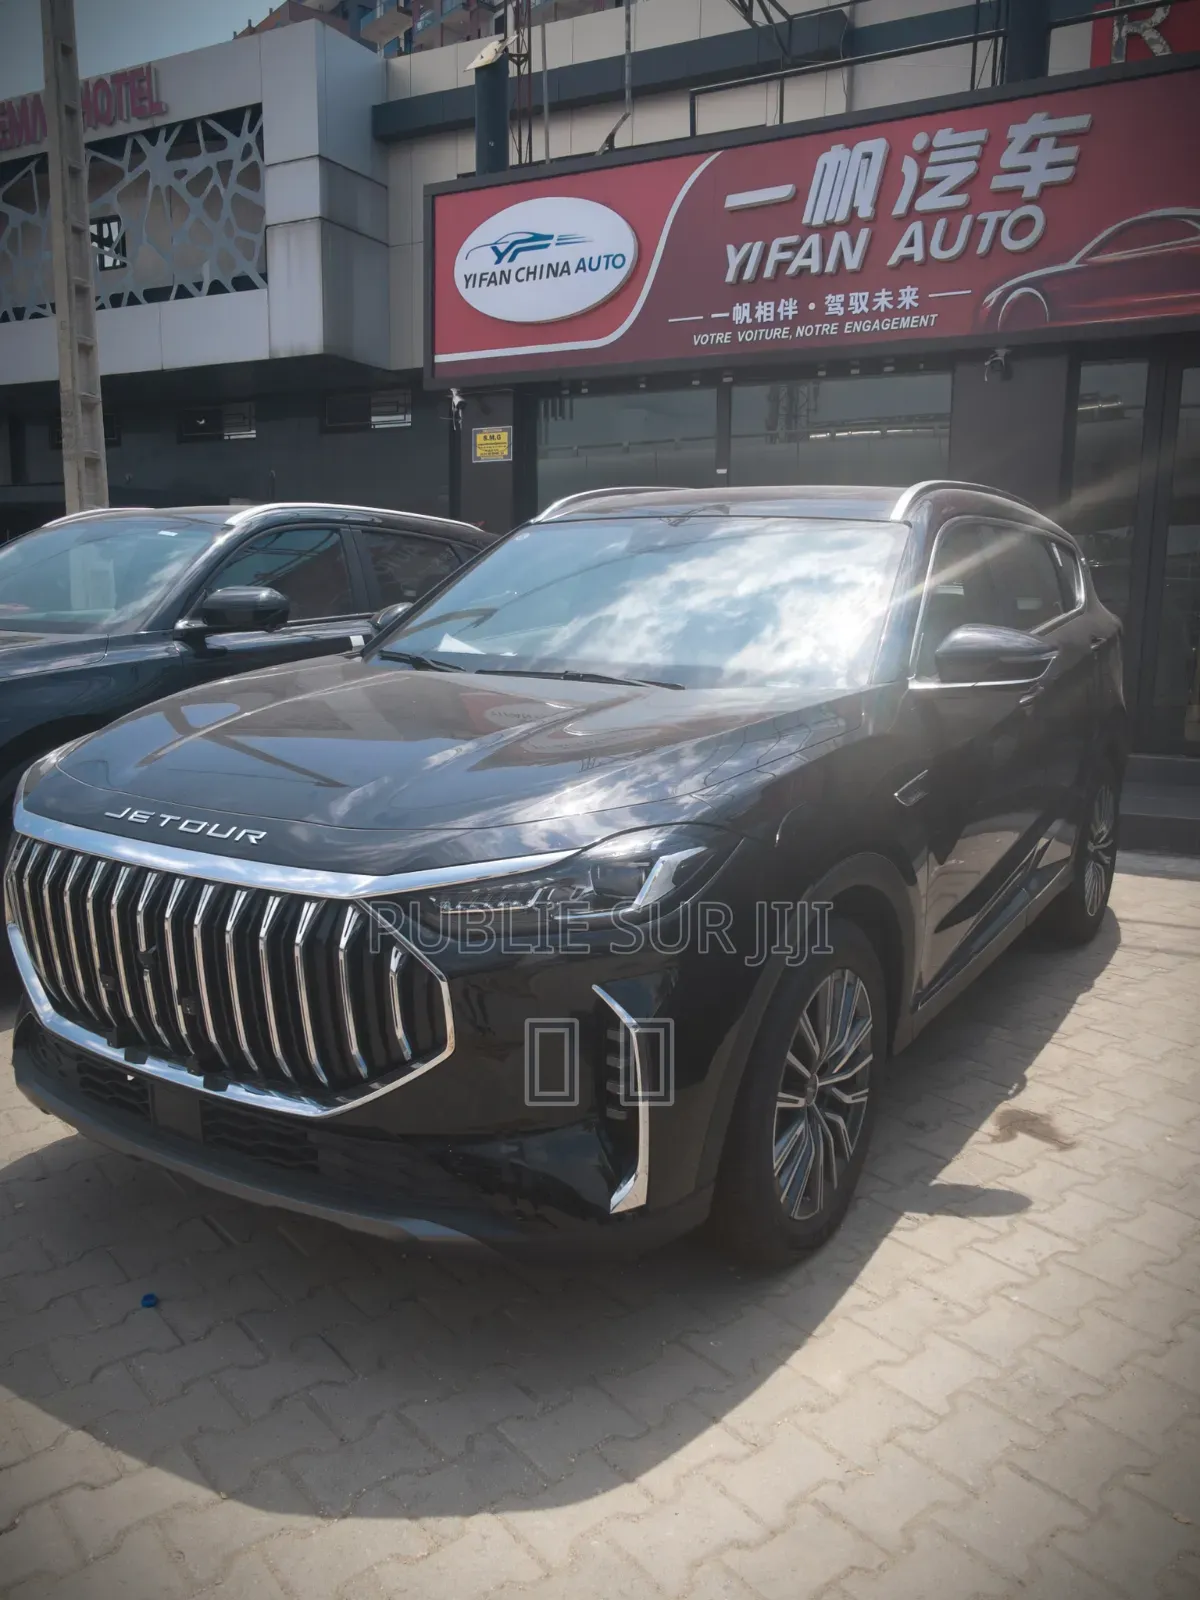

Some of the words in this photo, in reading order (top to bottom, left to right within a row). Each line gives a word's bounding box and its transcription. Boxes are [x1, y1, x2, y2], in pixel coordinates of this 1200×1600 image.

[723, 111, 1092, 228] 一帆汽车
[725, 227, 872, 284] YIFAN
[887, 204, 1047, 268] AUTO
[463, 269, 512, 289] YIFAN
[515, 260, 571, 283] CHINA
[574, 253, 626, 273] AUTO
[693, 331, 732, 346] VOTRE
[737, 326, 793, 342] VOITURE,
[795, 322, 839, 338] NOTRE
[844, 313, 938, 333] ENGAGEMENT
[104, 807, 267, 844] JETOUR
